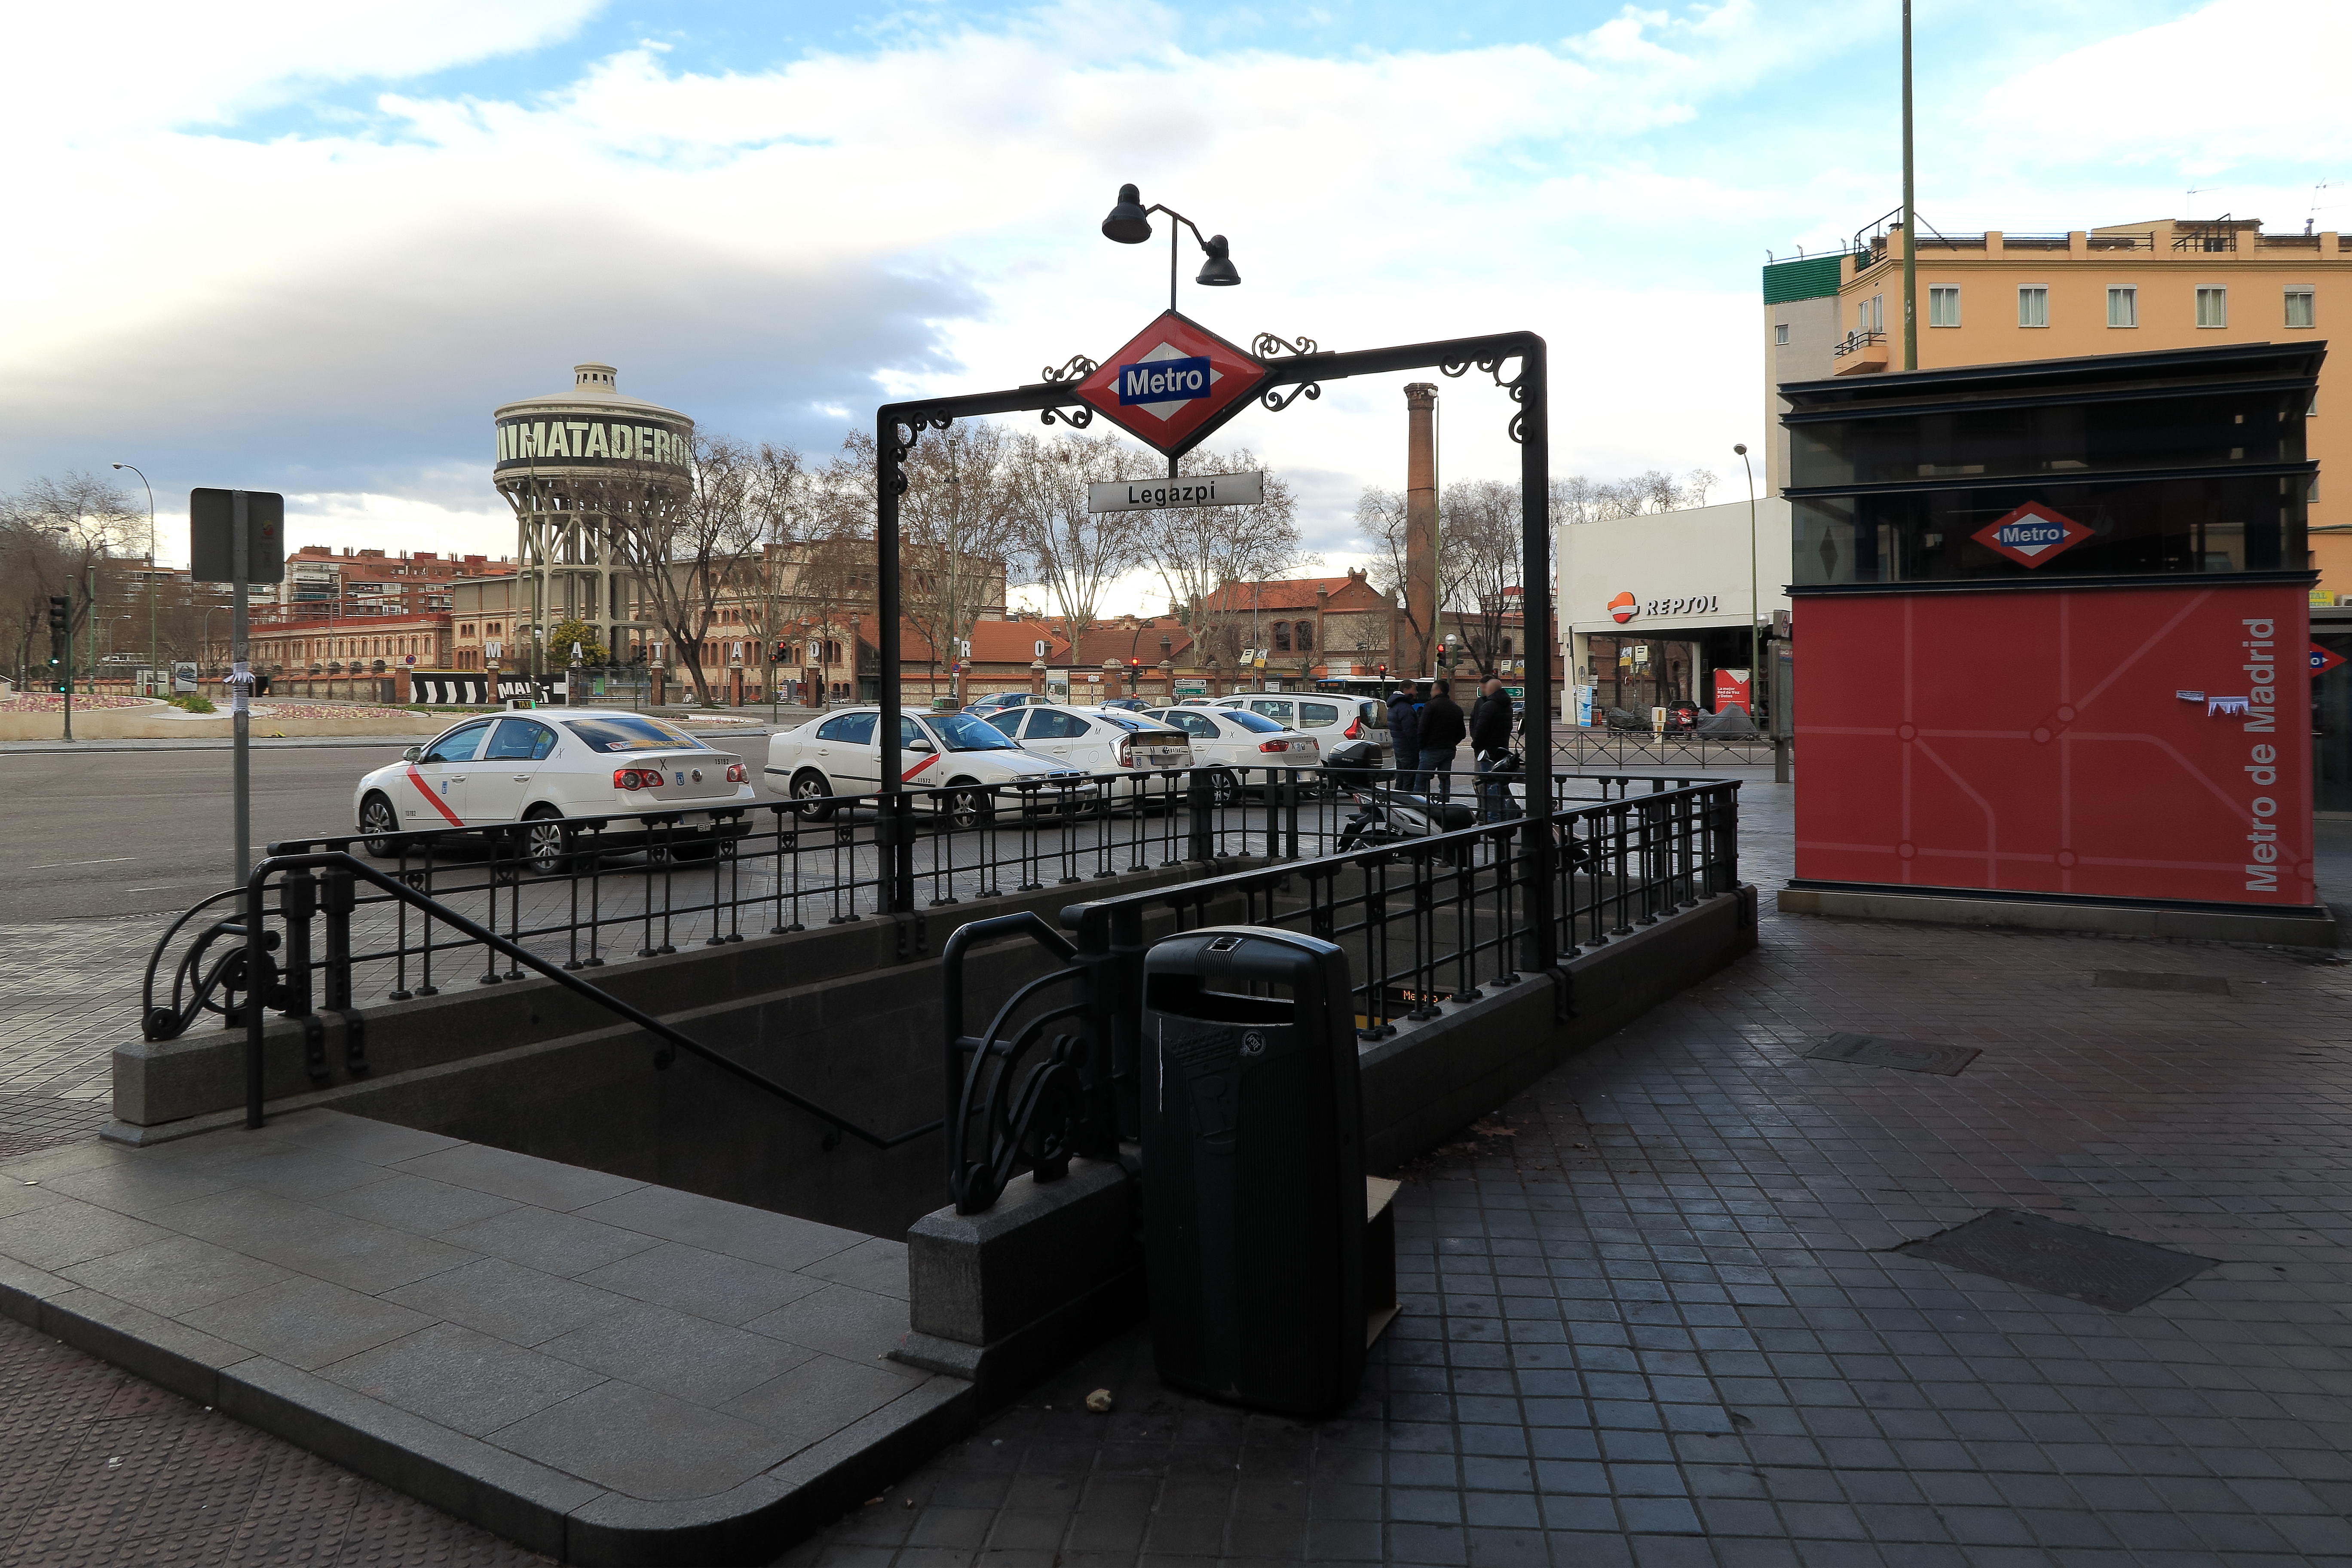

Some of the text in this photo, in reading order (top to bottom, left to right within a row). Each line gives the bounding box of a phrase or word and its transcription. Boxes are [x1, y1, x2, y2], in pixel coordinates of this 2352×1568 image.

[1127, 368, 1203, 396] Metro
[1128, 481, 1215, 506] Legazpi
[2003, 527, 2060, 542] Metro
[1646, 595, 1718, 615] REPSOL
[2242, 618, 2277, 891] Metro de Madrid
[1403, 990, 1438, 1003] Mero
